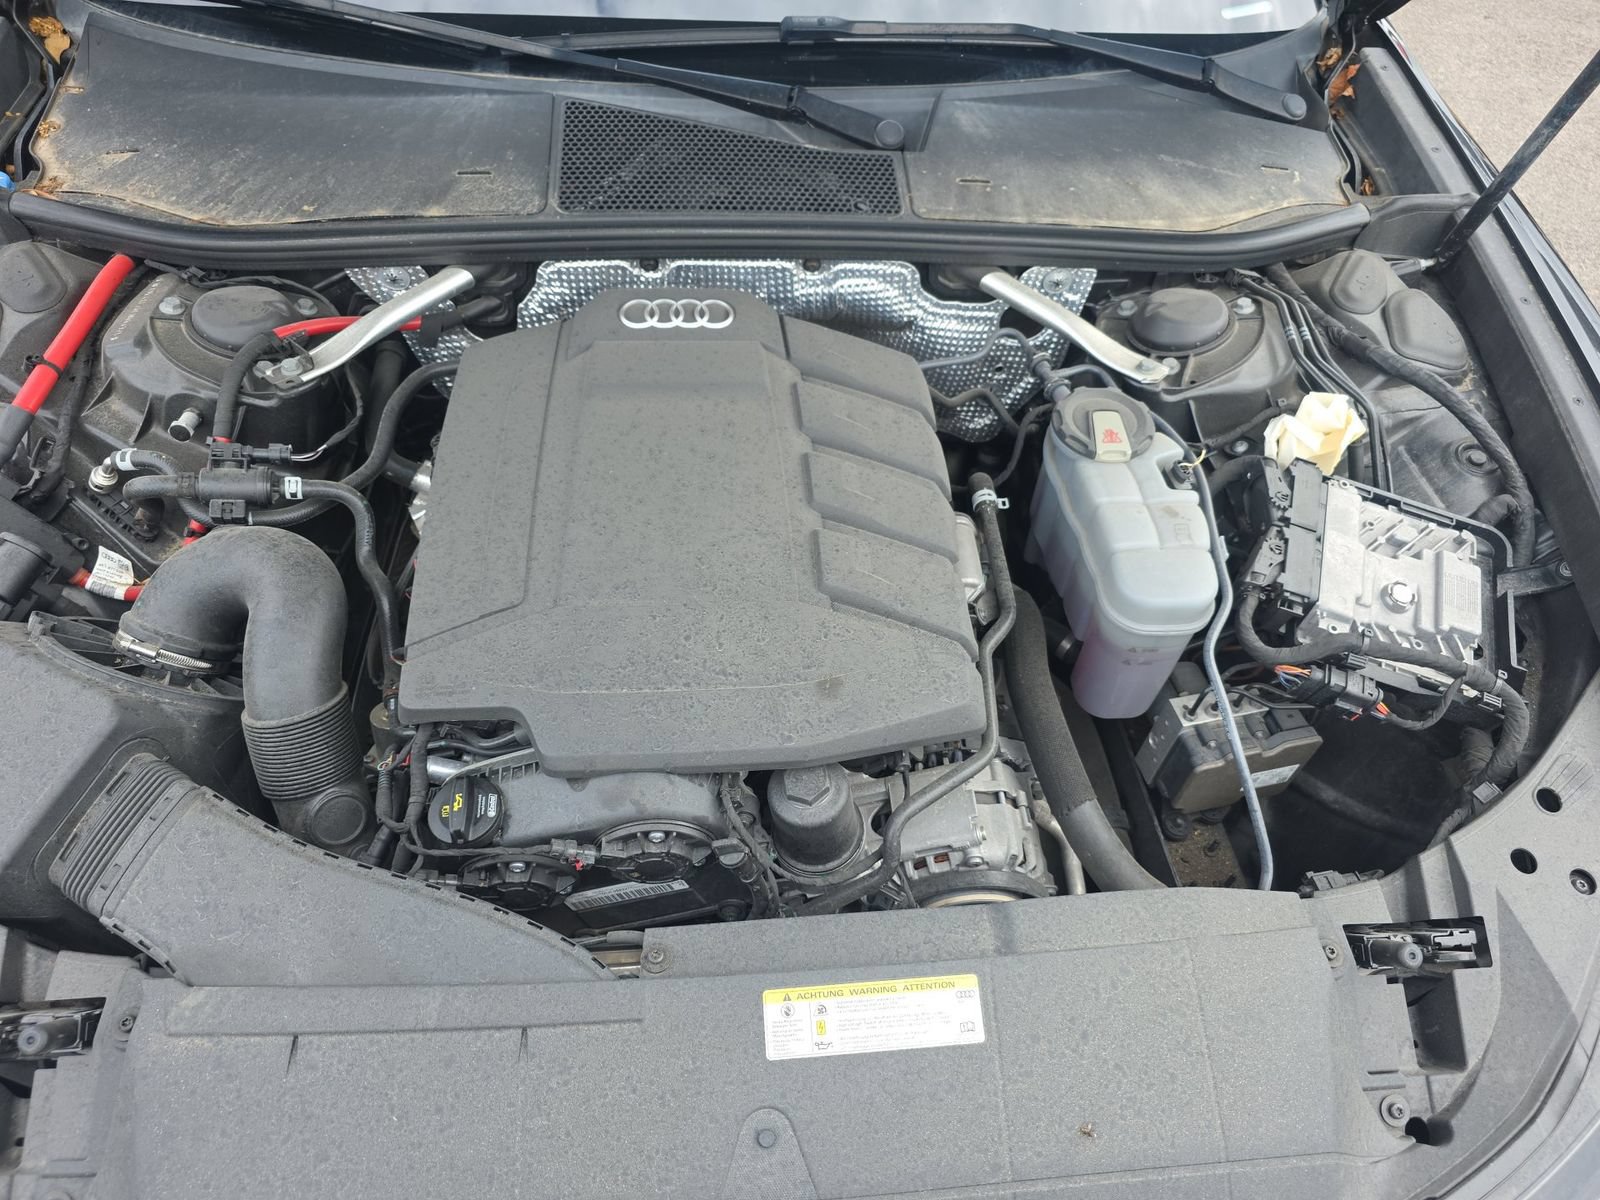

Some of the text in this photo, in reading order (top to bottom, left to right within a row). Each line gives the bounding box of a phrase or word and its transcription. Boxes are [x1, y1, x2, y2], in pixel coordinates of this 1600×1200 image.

[796, 981, 956, 1000] ACHTUNG WARNING ATTENTION
